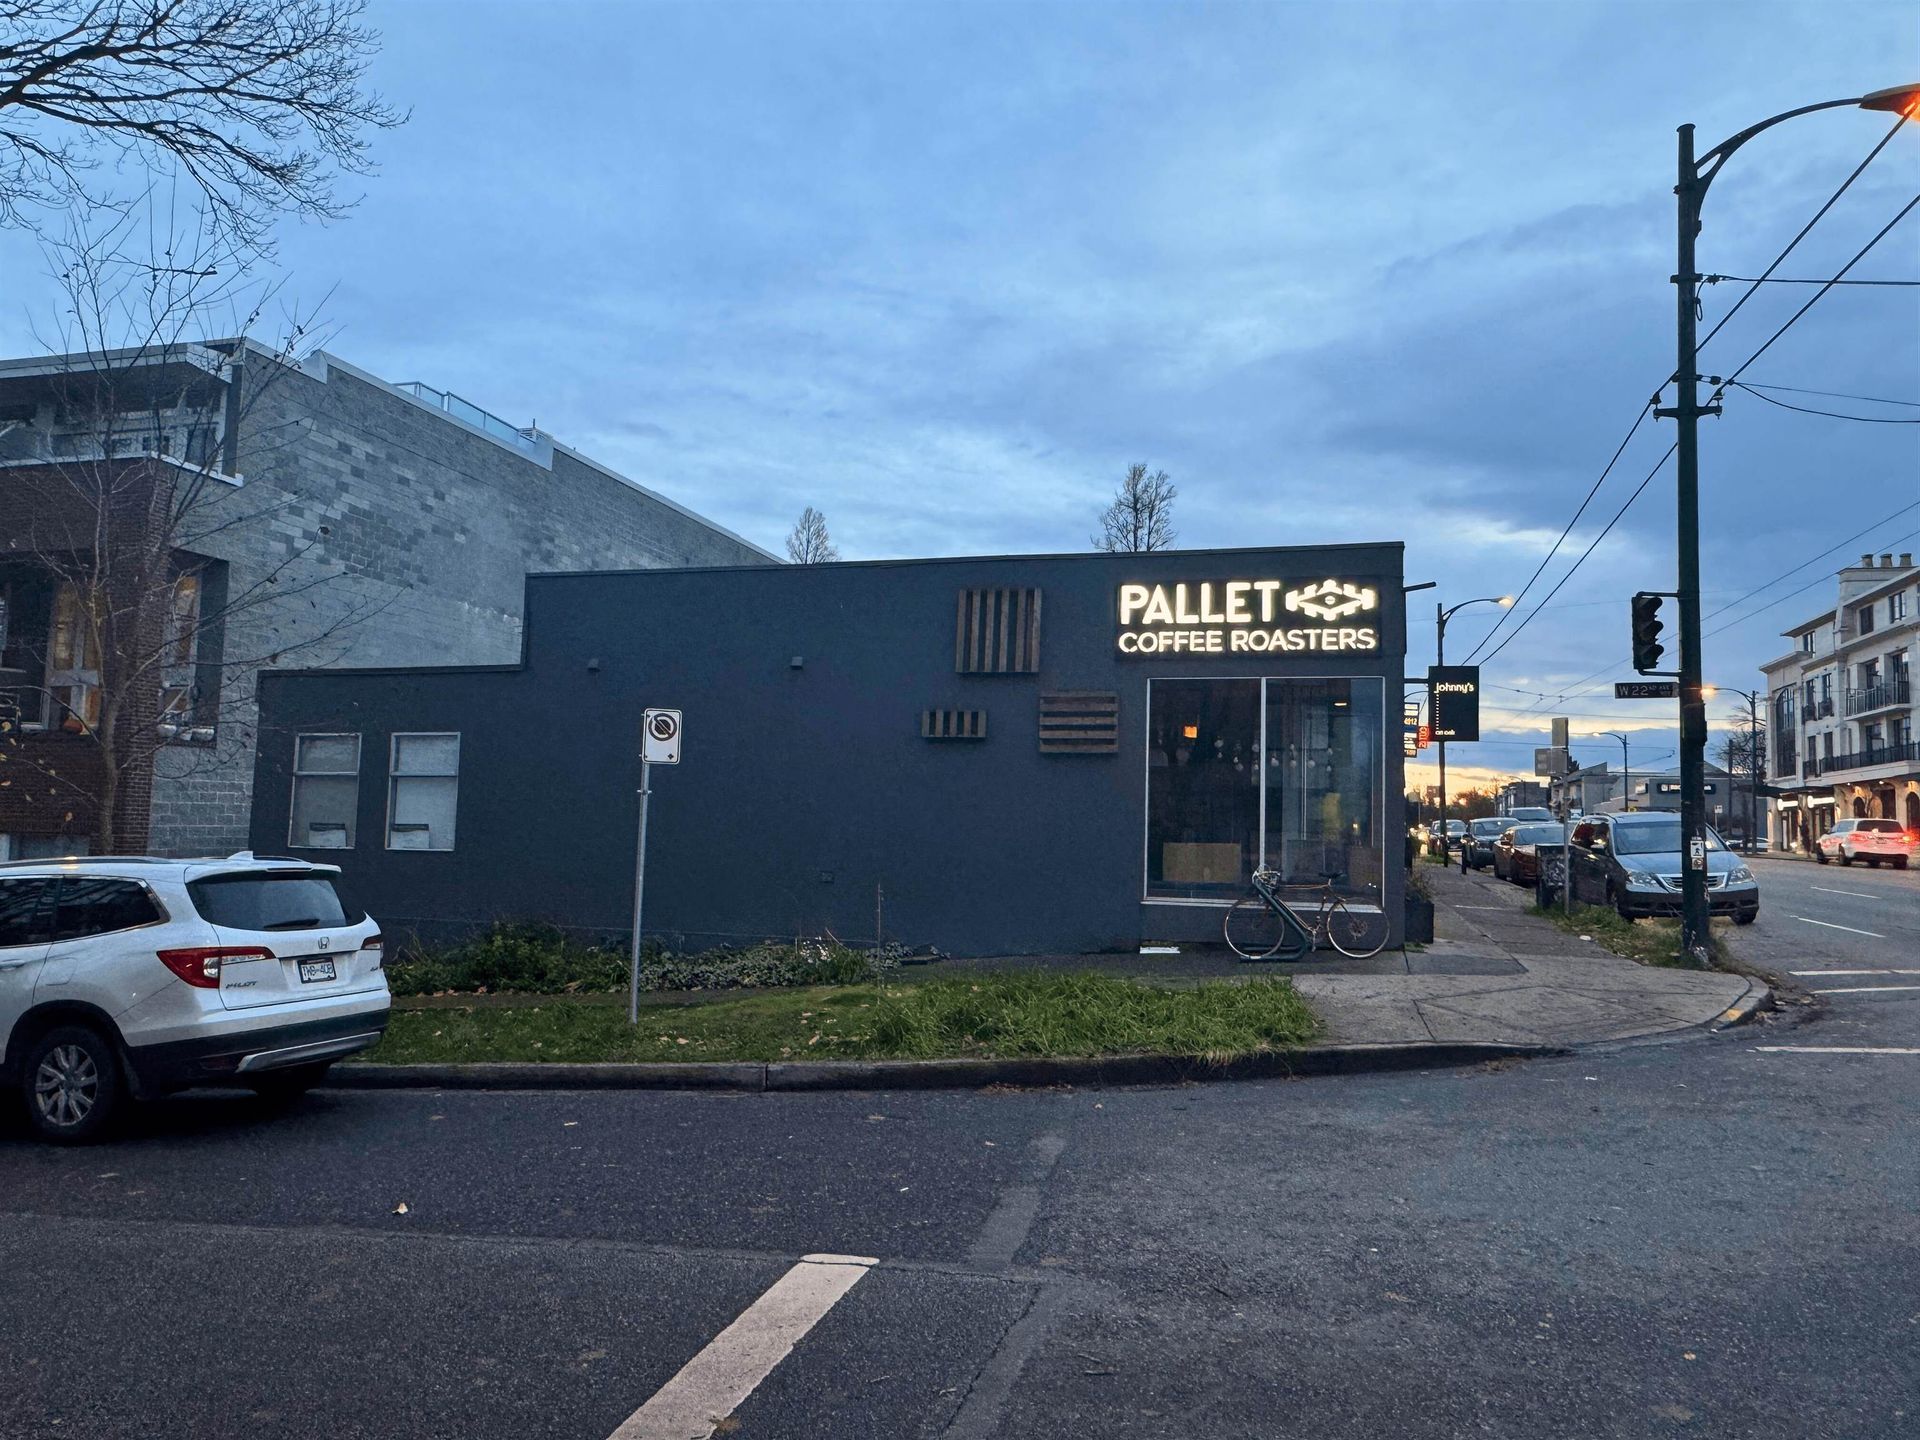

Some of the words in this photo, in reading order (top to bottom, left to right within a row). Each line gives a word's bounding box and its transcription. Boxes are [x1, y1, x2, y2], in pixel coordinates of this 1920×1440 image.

[1120, 581, 1280, 624] PALLET
[1118, 630, 1223, 653] COFFEE
[1230, 628, 1376, 652] ROASTERS
[1618, 685, 1629, 696] W
